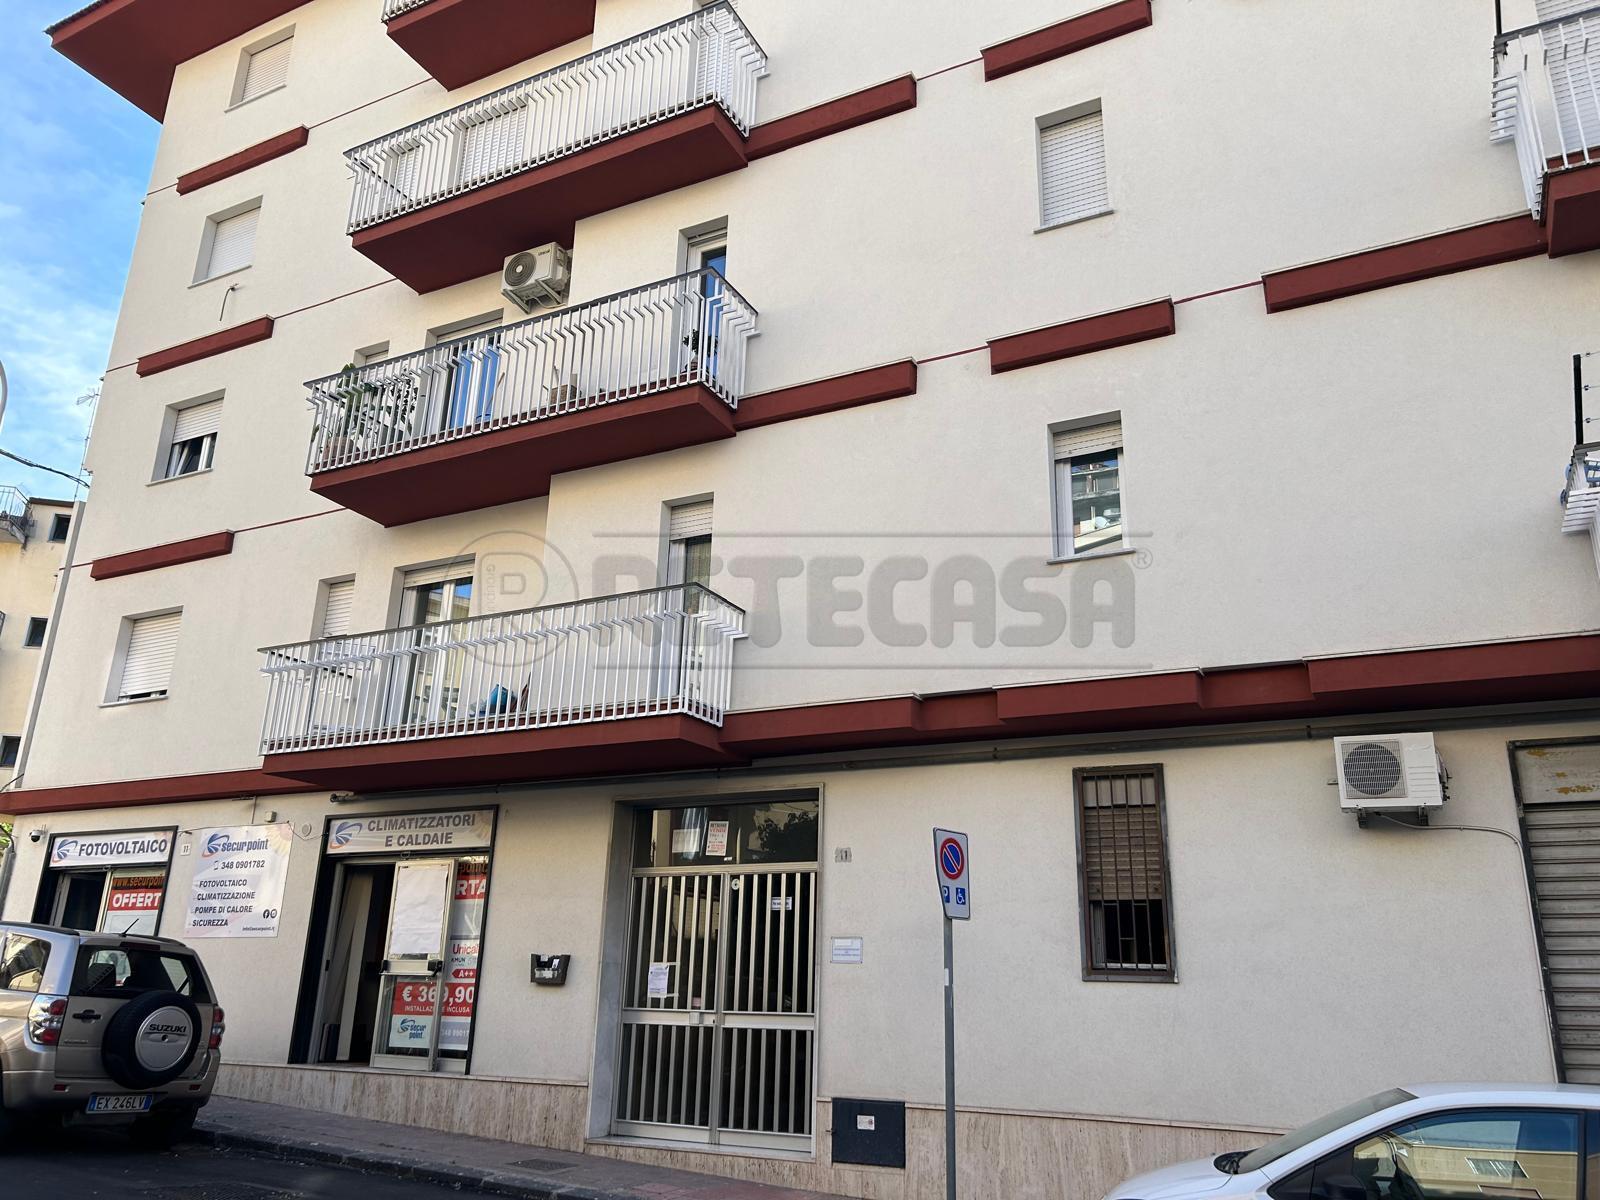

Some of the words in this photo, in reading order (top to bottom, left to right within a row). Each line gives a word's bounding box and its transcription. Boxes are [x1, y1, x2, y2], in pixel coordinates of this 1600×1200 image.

[367, 813, 476, 831] CLIMATIZZATORI
[221, 838, 269, 853] securpoint
[385, 835, 393, 847] E
[397, 832, 453, 847] CALDAIE
[78, 839, 167, 856] FOTOVOLTAICO
[221, 861, 234, 870] 348
[235, 860, 266, 869] 0901782
[199, 879, 248, 888] FOTOVOLTAICO
[456, 879, 486, 896] RTA
[112, 892, 162, 908] OFFERT
[197, 891, 256, 901] CLIMATIZZAZIONE
[194, 906, 217, 914] POMPE
[218, 906, 225, 914] DI
[226, 905, 254, 913] CALORE
[192, 919, 229, 927] SICUREZZA
[402, 985, 413, 1002] €
[149, 1023, 187, 1033] SUZUKI
[96, 1096, 111, 1110] EX
